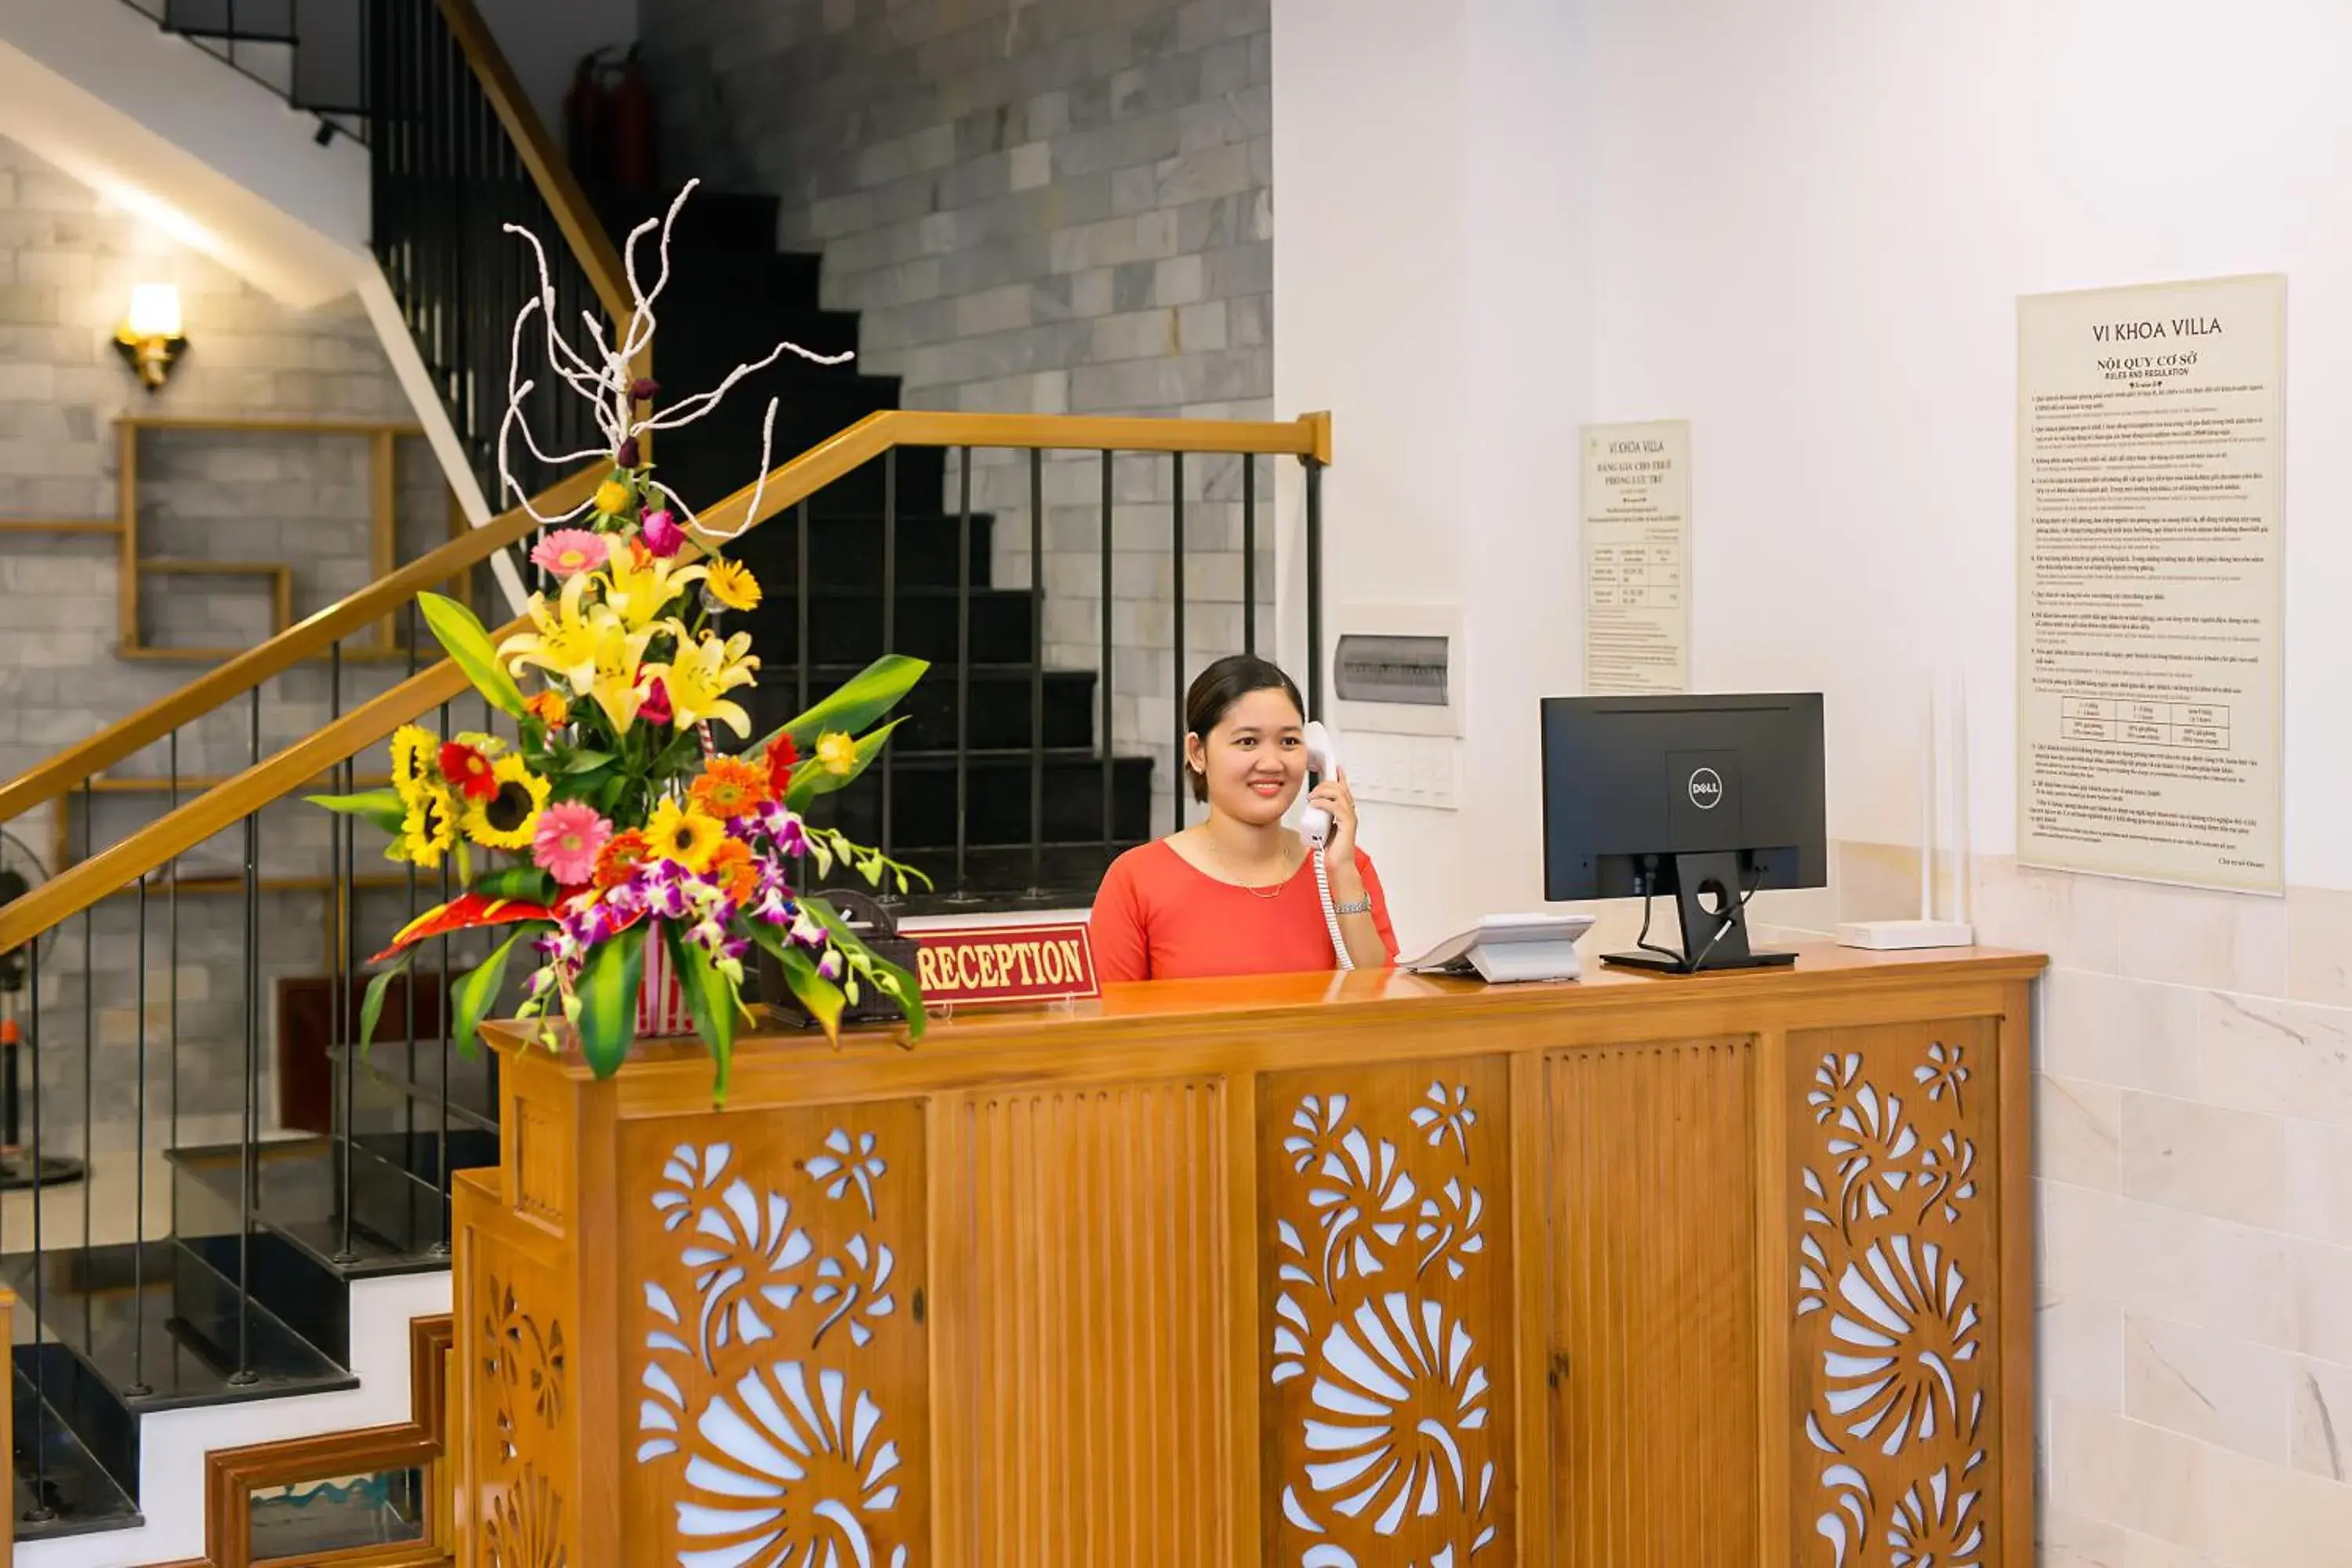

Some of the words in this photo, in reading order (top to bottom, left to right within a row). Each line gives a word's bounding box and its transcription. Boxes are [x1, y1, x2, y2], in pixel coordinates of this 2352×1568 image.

[2092, 325, 2110, 343] VI
[2115, 321, 2166, 342] KHOA
[2172, 317, 2222, 336] VILLA
[2096, 357, 2122, 371] NỘI
[2124, 357, 2153, 369] QUY
[2157, 354, 2177, 366] CƠ
[1693, 782, 1719, 793] DELL
[917, 940, 1083, 991] RECEPTION
